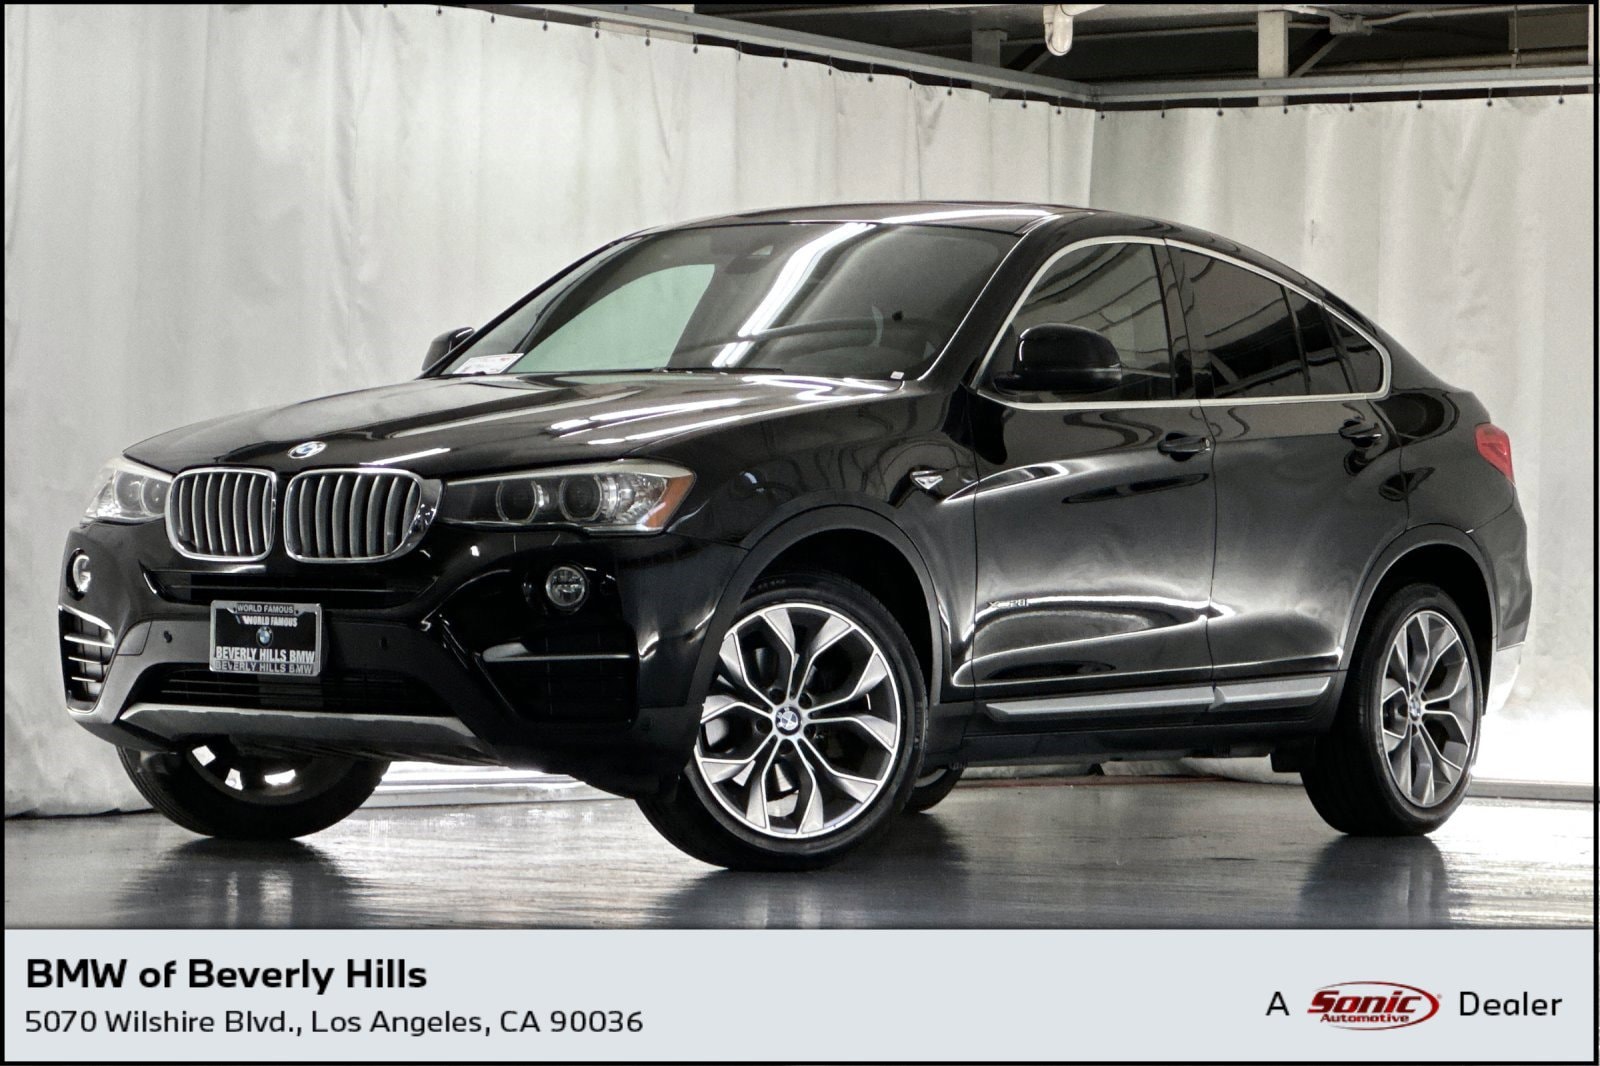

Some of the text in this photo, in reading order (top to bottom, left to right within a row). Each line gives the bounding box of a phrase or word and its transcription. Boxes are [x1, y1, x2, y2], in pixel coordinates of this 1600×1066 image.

[237, 604, 294, 614] WORLD FAMOUS
[242, 616, 270, 625] WORLD
[216, 646, 315, 664] BEVERLY HILLS BMW
[215, 660, 313, 674] BEVERLY HILLS BMW
